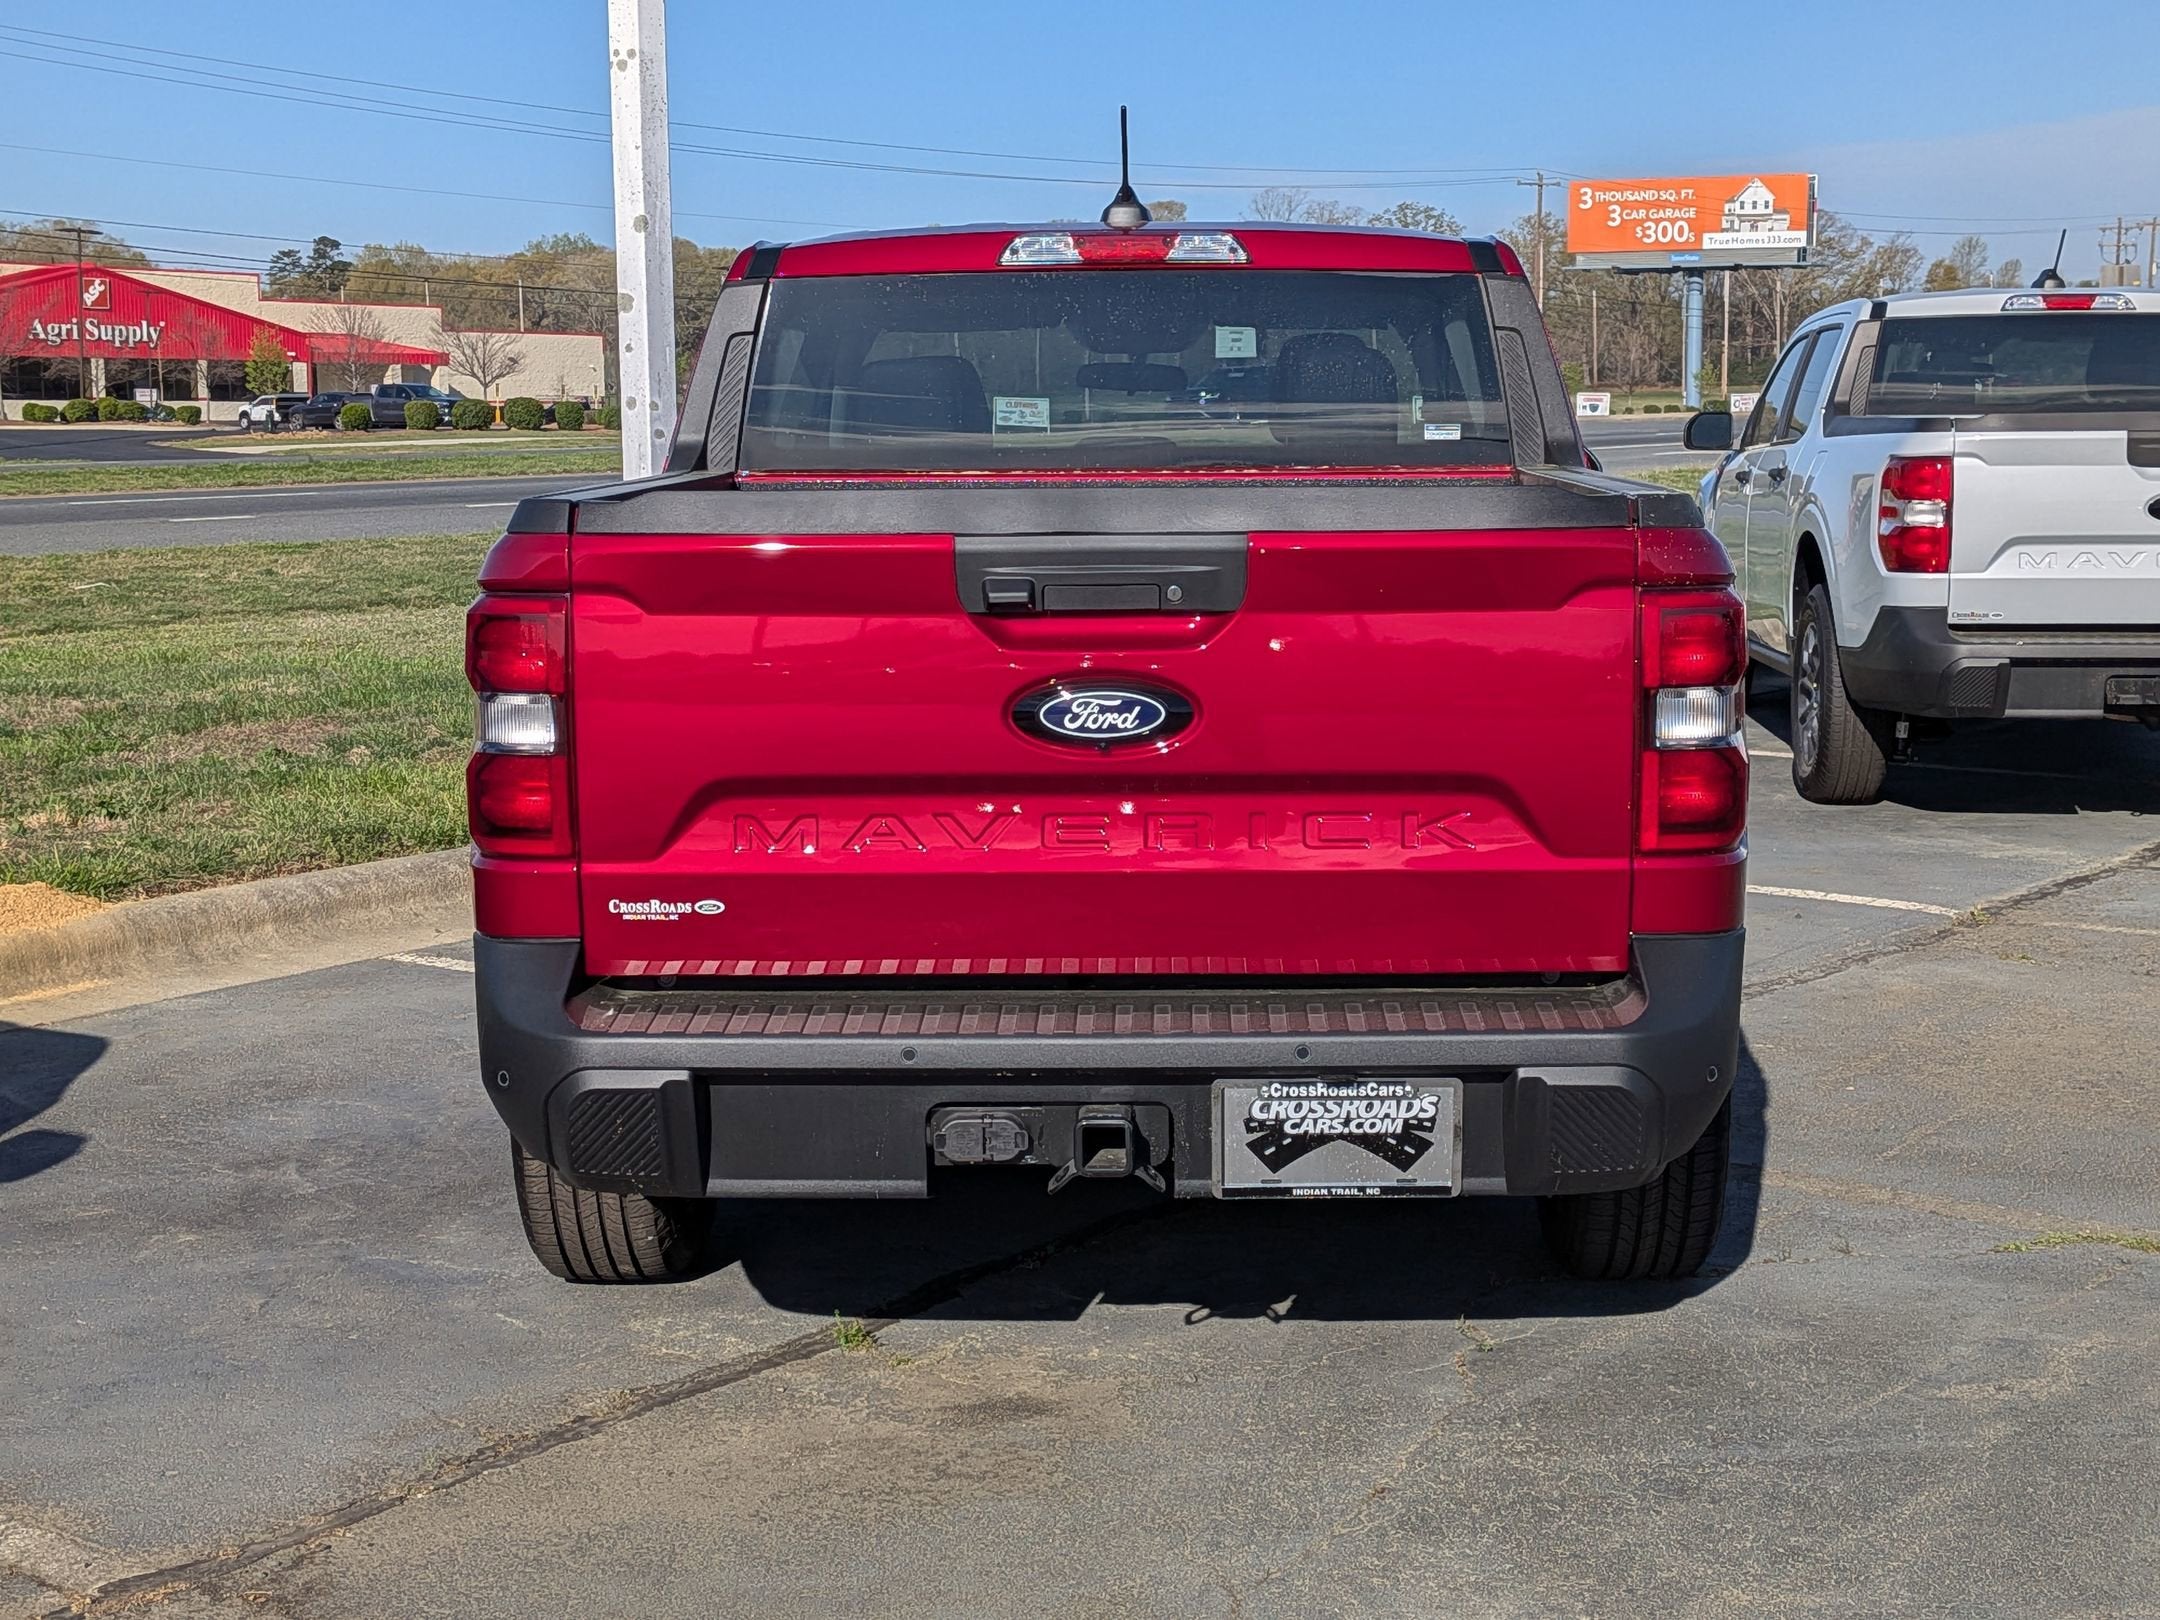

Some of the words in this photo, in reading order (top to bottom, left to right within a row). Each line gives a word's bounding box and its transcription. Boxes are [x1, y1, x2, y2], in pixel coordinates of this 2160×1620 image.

[1579, 187, 1593, 210] 3
[1594, 190, 1659, 203] THOUSAND
[1659, 189, 1679, 202] SQ.
[1681, 188, 1697, 200] FT.
[1606, 204, 1621, 227] 3
[1622, 209, 1647, 220] CAR
[1648, 207, 1697, 219] GARAGE
[1708, 234, 1802, 246] TrueHomes333.com
[83, 279, 106, 306] ASC
[28, 317, 80, 346] Agri
[85, 317, 160, 348] Supply
[2018, 551, 2160, 569] MAV
[1064, 698, 1141, 730] Ford
[731, 810, 1480, 855] MAVERICK
[1251, 1093, 1440, 1120] CROSSROADS
[1283, 1117, 1405, 1135] CARS.COM
[1292, 1187, 1329, 1196] INDIAN
[1331, 1187, 1363, 1197] TRAIL,
[1366, 1187, 1381, 1196] NC
